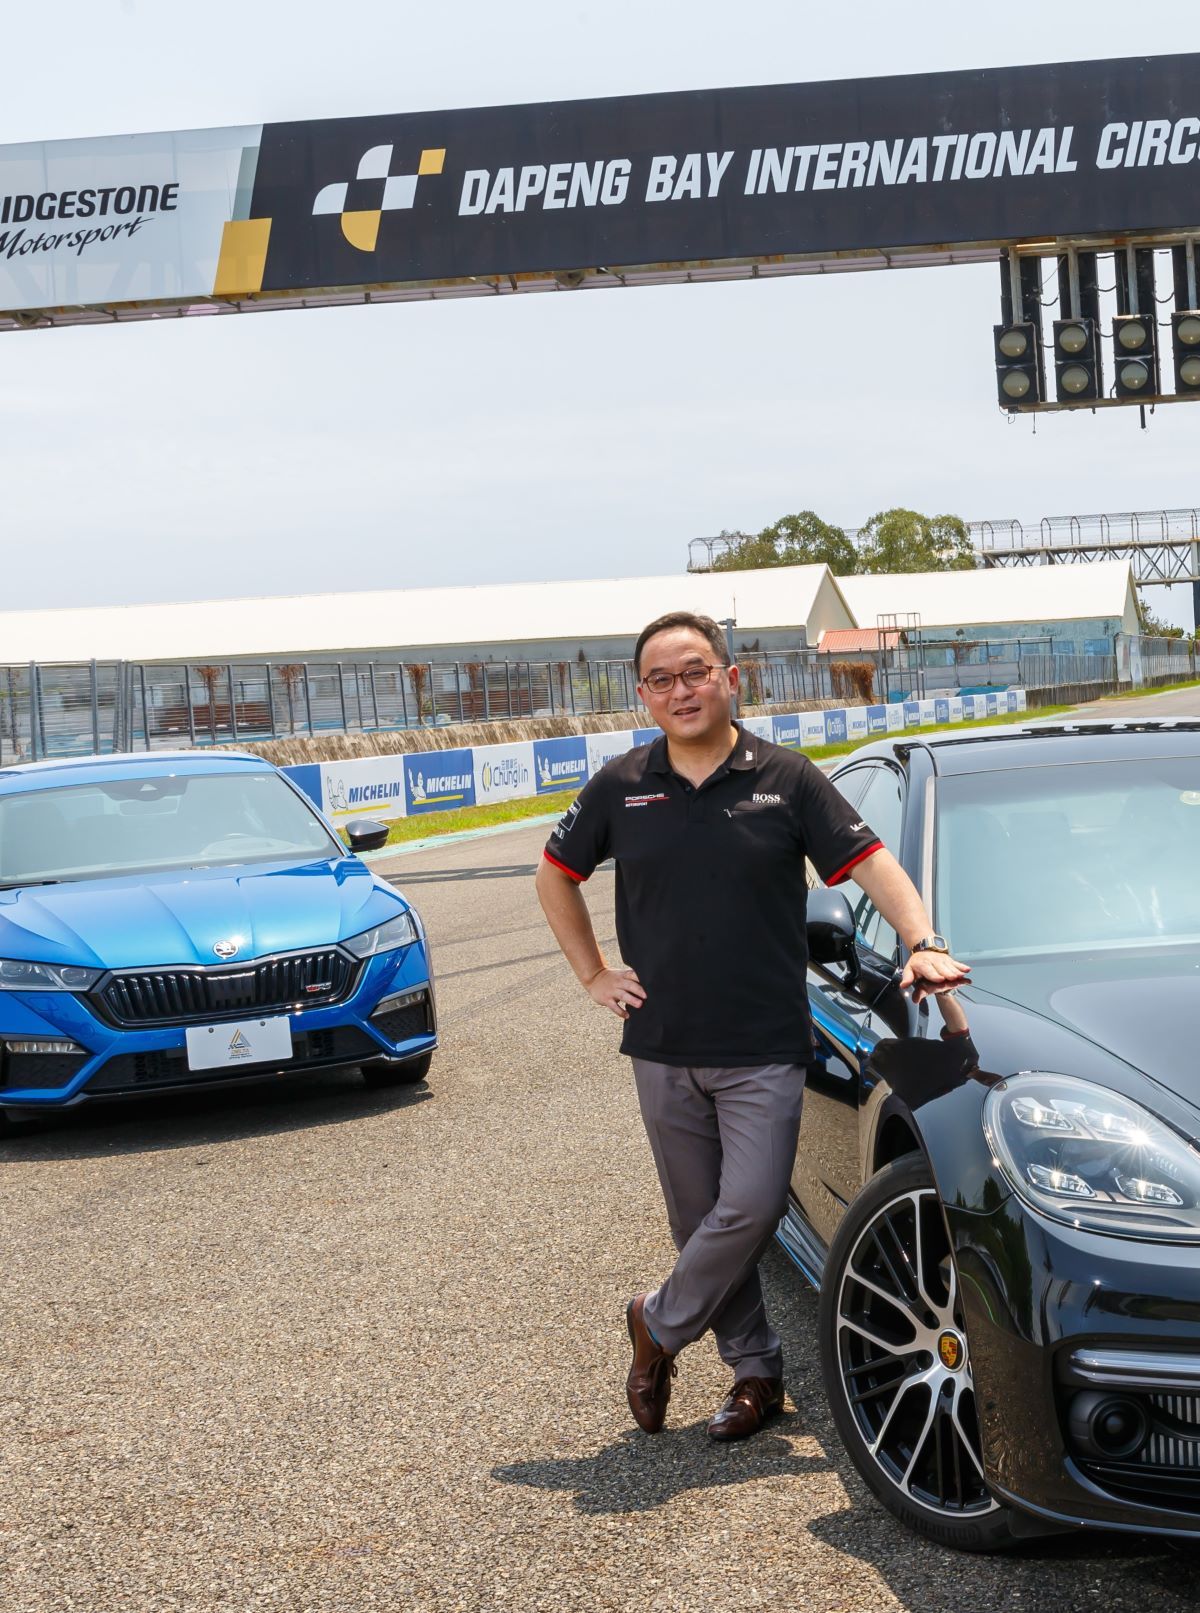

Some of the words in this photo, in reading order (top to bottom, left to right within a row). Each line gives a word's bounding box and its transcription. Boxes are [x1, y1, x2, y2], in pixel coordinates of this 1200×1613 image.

[459, 159, 632, 216] DAPENG
[645, 151, 735, 202] BAY
[744, 126, 1078, 195] INTERNATIONAL
[0, 216, 155, 260] Motorsport
[552, 759, 586, 776] MICHELIN
[348, 782, 400, 803] MICHELIN
[427, 774, 471, 793] MICHELIN
[625, 793, 665, 801] PORSCHE
[752, 793, 781, 801] BOSS
